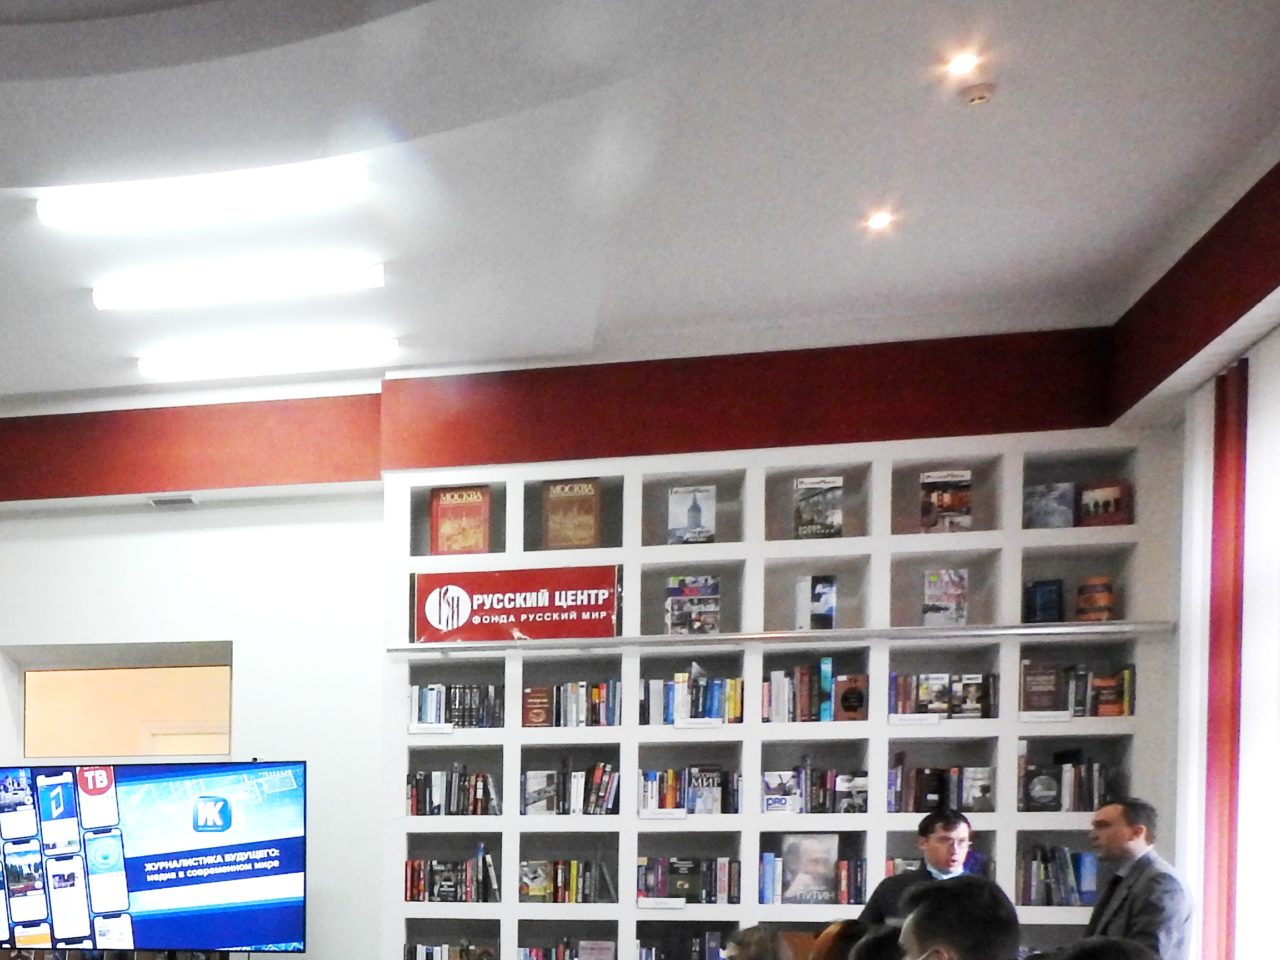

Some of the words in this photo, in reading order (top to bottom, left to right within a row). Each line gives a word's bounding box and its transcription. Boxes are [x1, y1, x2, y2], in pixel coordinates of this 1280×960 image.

[440, 491, 483, 503] МОСКВА
[549, 484, 595, 496] МОСКВА
[472, 589, 549, 610] РУССКИЙ
[554, 589, 609, 608] ЦЕНТР
[472, 614, 516, 625] ФОНДА
[520, 611, 577, 622] РУССКИЙ
[582, 611, 607, 620] МИР
[84, 770, 108, 790] ТВ
[691, 777, 721, 788] МИР
[144, 855, 223, 872] ЖУРНАЛИСТИКА
[224, 848, 280, 862] БУДУЩЕГО:
[178, 870, 185, 878] в
[186, 862, 252, 878] современном
[254, 859, 280, 870] мире
